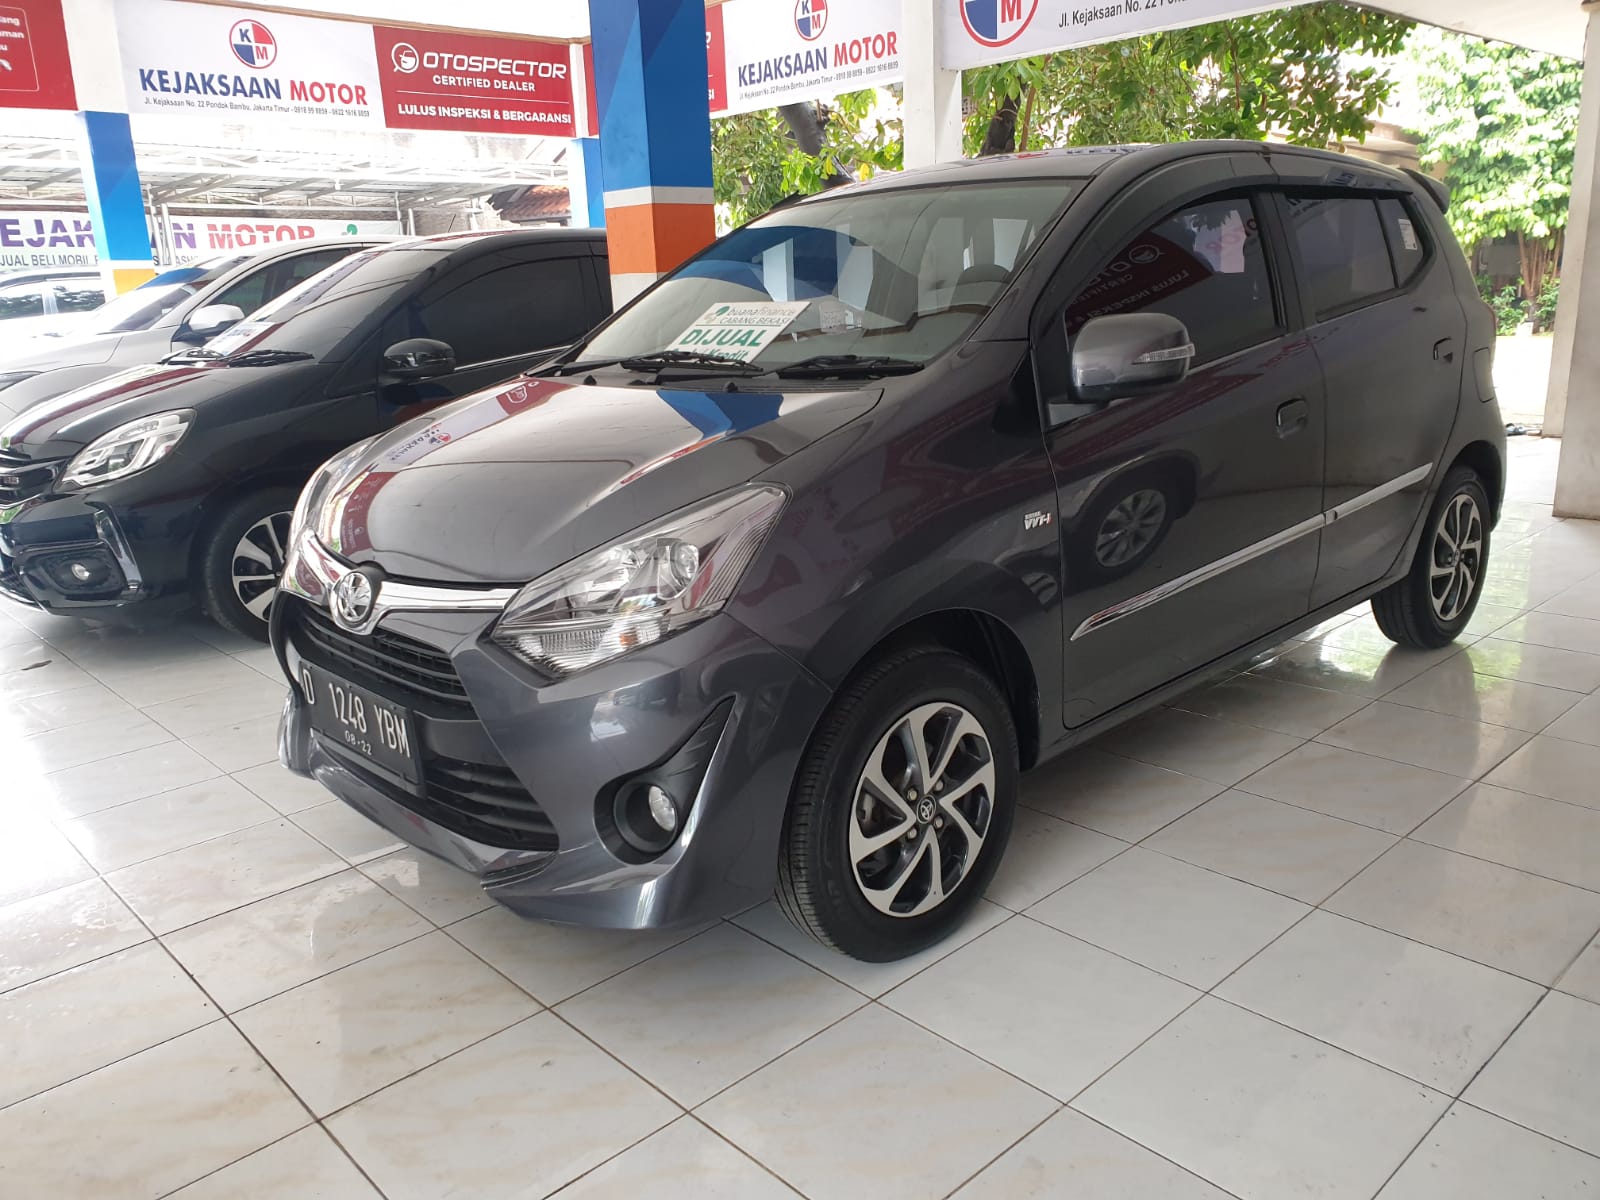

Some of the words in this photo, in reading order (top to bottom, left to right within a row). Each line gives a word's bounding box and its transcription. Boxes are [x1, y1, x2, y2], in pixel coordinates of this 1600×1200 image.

[1000, 0, 1022, 24] M
[1058, 13, 1070, 28] Jl.
[1072, 4, 1122, 26] Kejaksaan
[1125, 0, 1142, 14] No.
[811, 14, 821, 30] M
[238, 28, 252, 42] K
[255, 46, 269, 60] M
[738, 47, 828, 87] KEJAKSAAN
[833, 31, 898, 68] MOTOR
[422, 52, 567, 80] OTOSPECTOR
[138, 68, 282, 100] KEJAKSAAN
[290, 80, 368, 106] MOTOR
[432, 75, 491, 89] CERTIFIED
[493, 79, 536, 92] DEALER
[153, 97, 185, 107] Kejaksaan
[198, 100, 206, 108] 22
[206, 100, 229, 109] Pondok
[253, 103, 273, 112] Jakarta
[274, 105, 290, 113] Timur
[397, 104, 437, 117] LULUS
[438, 106, 491, 120] INSPEKSI
[493, 110, 501, 120] &
[502, 110, 572, 124] BERGARANSI
[0, 254, 29, 267] JUAL
[31, 254, 57, 266] BELI
[679, 329, 768, 347] DIJUAL
[303, 668, 316, 705] D
[328, 682, 368, 734] 1248
[373, 704, 411, 759] YBM
